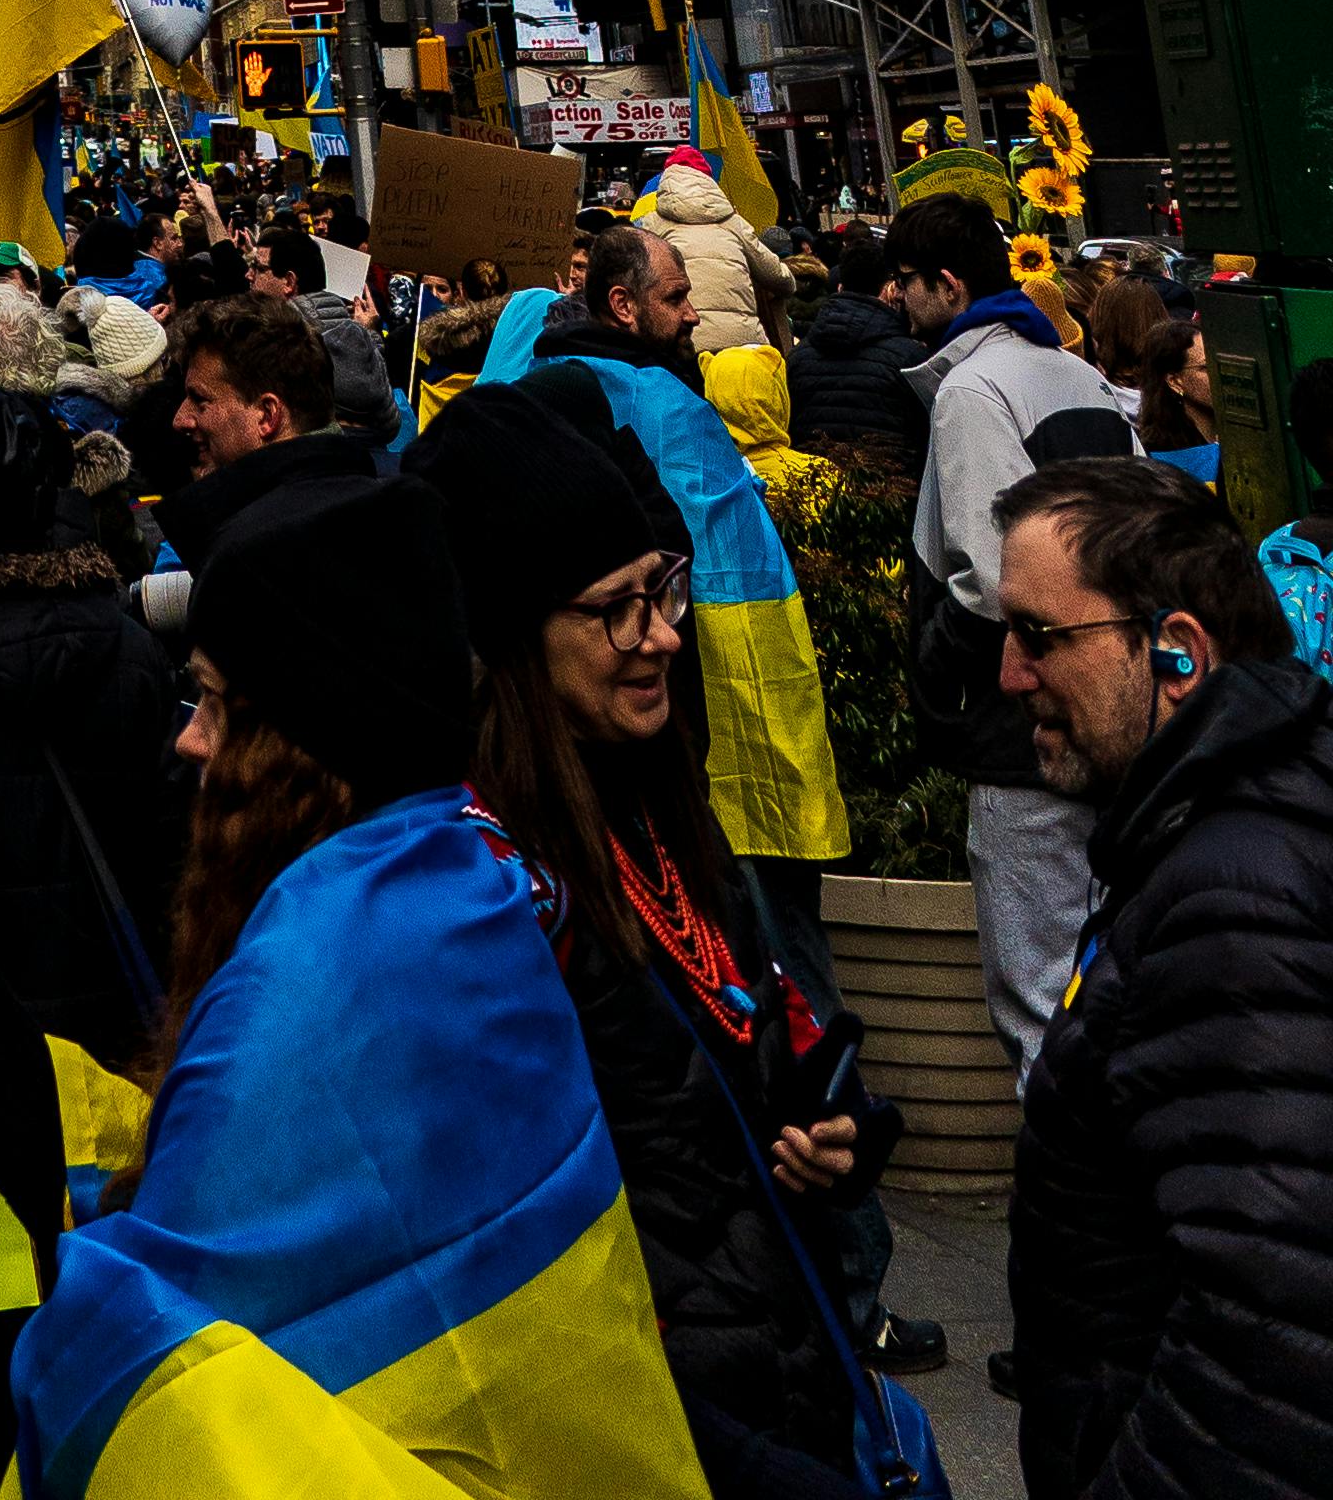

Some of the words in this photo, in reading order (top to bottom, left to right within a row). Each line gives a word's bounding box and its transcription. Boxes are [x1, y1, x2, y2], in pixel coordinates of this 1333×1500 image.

[616, 101, 665, 120] Sale
[638, 130, 668, 141] OFF
[395, 159, 451, 184] STOP
[499, 177, 554, 198] HELP
[383, 185, 450, 218] PUTIN
